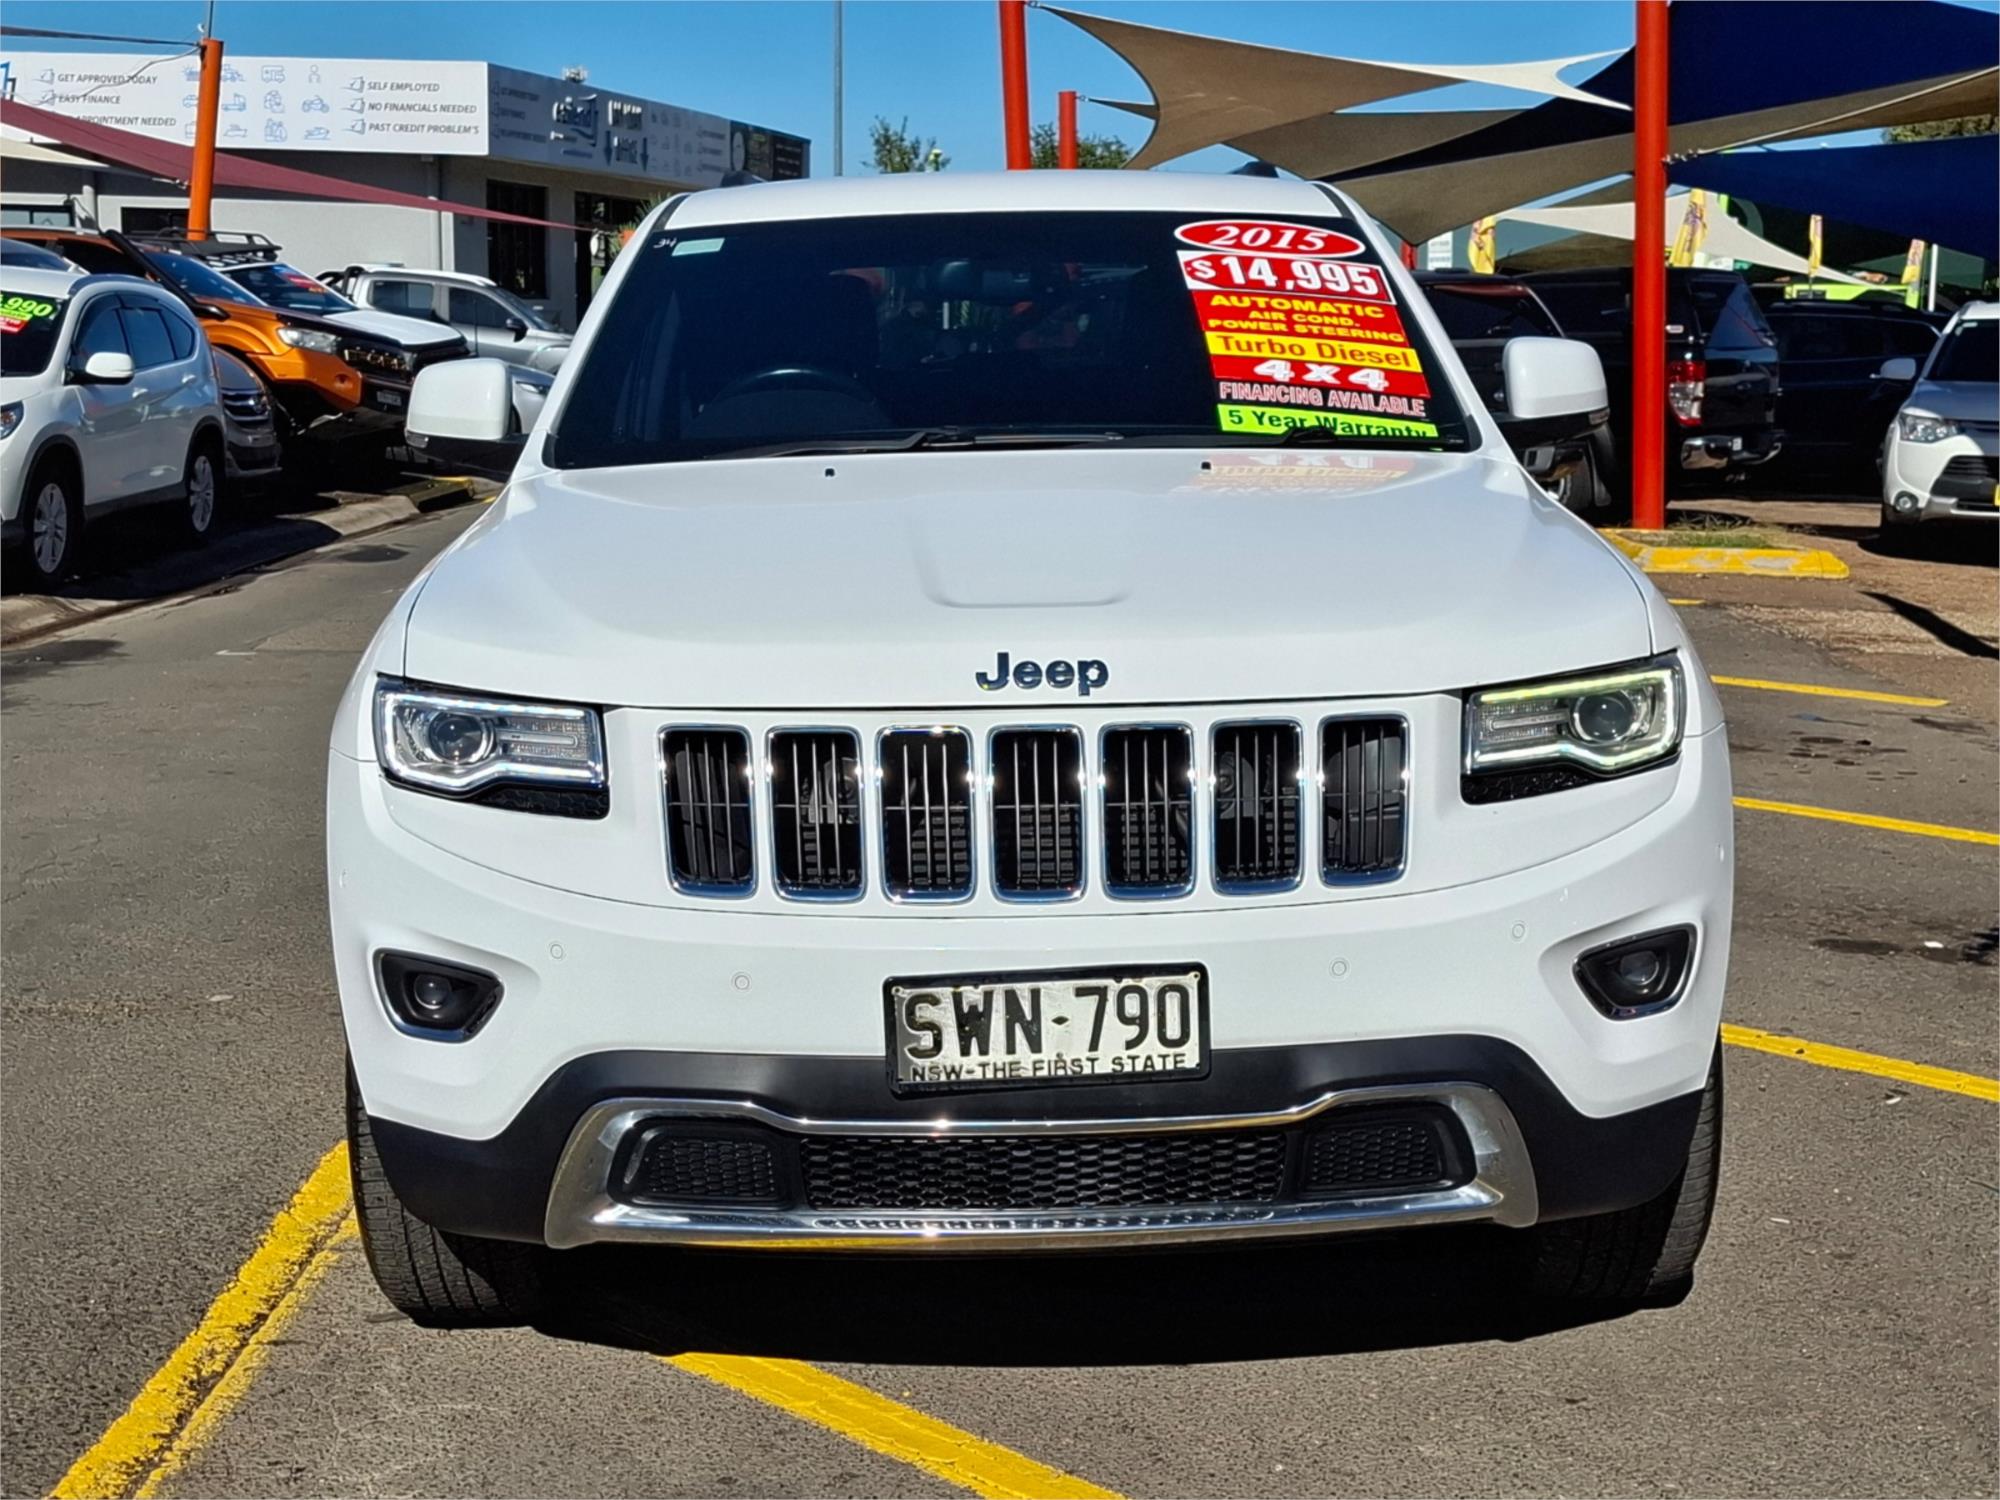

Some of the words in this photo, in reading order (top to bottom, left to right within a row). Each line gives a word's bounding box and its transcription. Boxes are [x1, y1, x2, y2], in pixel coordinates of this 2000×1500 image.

[58, 73, 74, 82] GET
[77, 74, 128, 83] APPROVED
[128, 75, 158, 84] TODAY
[367, 81, 388, 90] SELF
[390, 82, 440, 92] EMPLOYED
[58, 95, 81, 103] EASY
[82, 95, 121, 104] FINANCE
[368, 102, 382, 111] NO
[384, 103, 438, 113] FINANCIALS
[439, 104, 477, 113] NEEDED
[140, 117, 177, 126] NEEDED
[368, 123, 391, 132] PAST
[392, 123, 426, 133] CREDIT
[427, 124, 480, 134] PROBLEM'S
[1208, 225, 1329, 250] 2015
[1189, 255, 1380, 296] $14,995
[1210, 294, 1386, 318] AUTOMATIC
[1248, 310, 1287, 321] AIR
[1292, 313, 1361, 327] COND.
[1208, 319, 1289, 332] POWER
[1294, 325, 1405, 342] STEERING
[1216, 335, 1306, 357] Turbo
[1316, 342, 1411, 367] Diesel
[1219, 381, 1324, 405] FINANCING
[1327, 390, 1427, 417] AVAILABLE
[1229, 409, 1243, 424] 5
[1251, 410, 1308, 429] Year
[975, 652, 1109, 696] Jeep
[1032, 1056, 1100, 1078] FIRST
[1111, 1053, 1187, 1074] STATE
